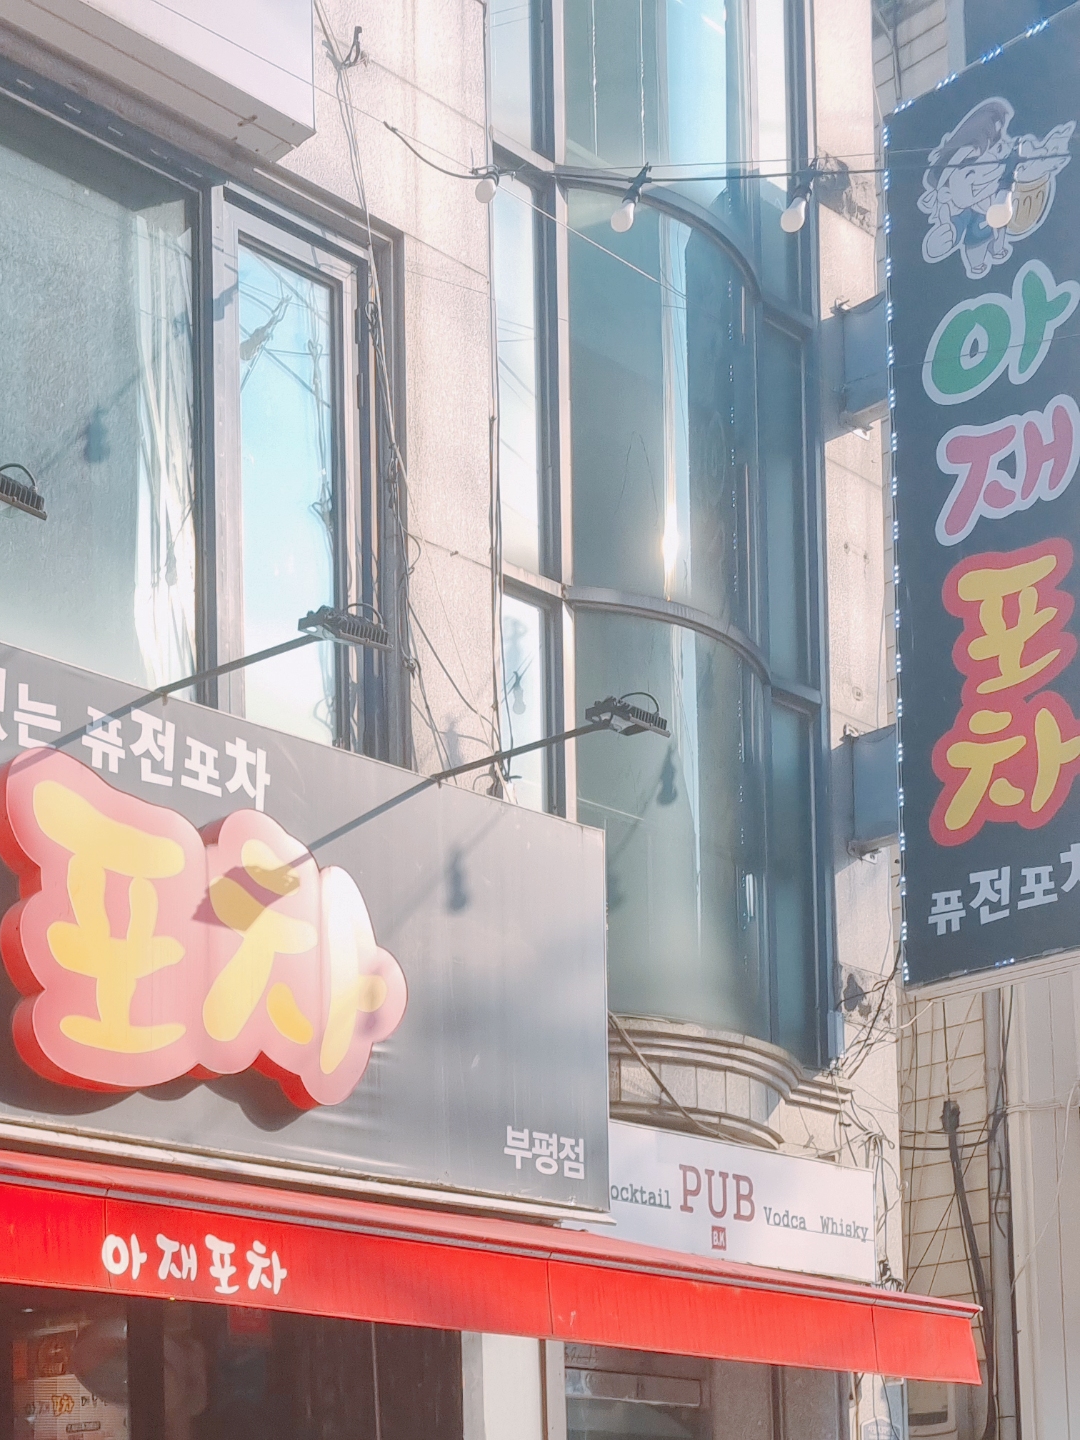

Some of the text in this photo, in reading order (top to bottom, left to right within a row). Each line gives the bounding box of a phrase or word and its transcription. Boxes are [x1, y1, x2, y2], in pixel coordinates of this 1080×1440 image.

[82, 704, 271, 808] 퓨전포차
[503, 1124, 586, 1181] 부평점
[610, 1163, 869, 1242] ocktail PUB Vodca Whisky
[101, 1232, 288, 1295] 아재포차
